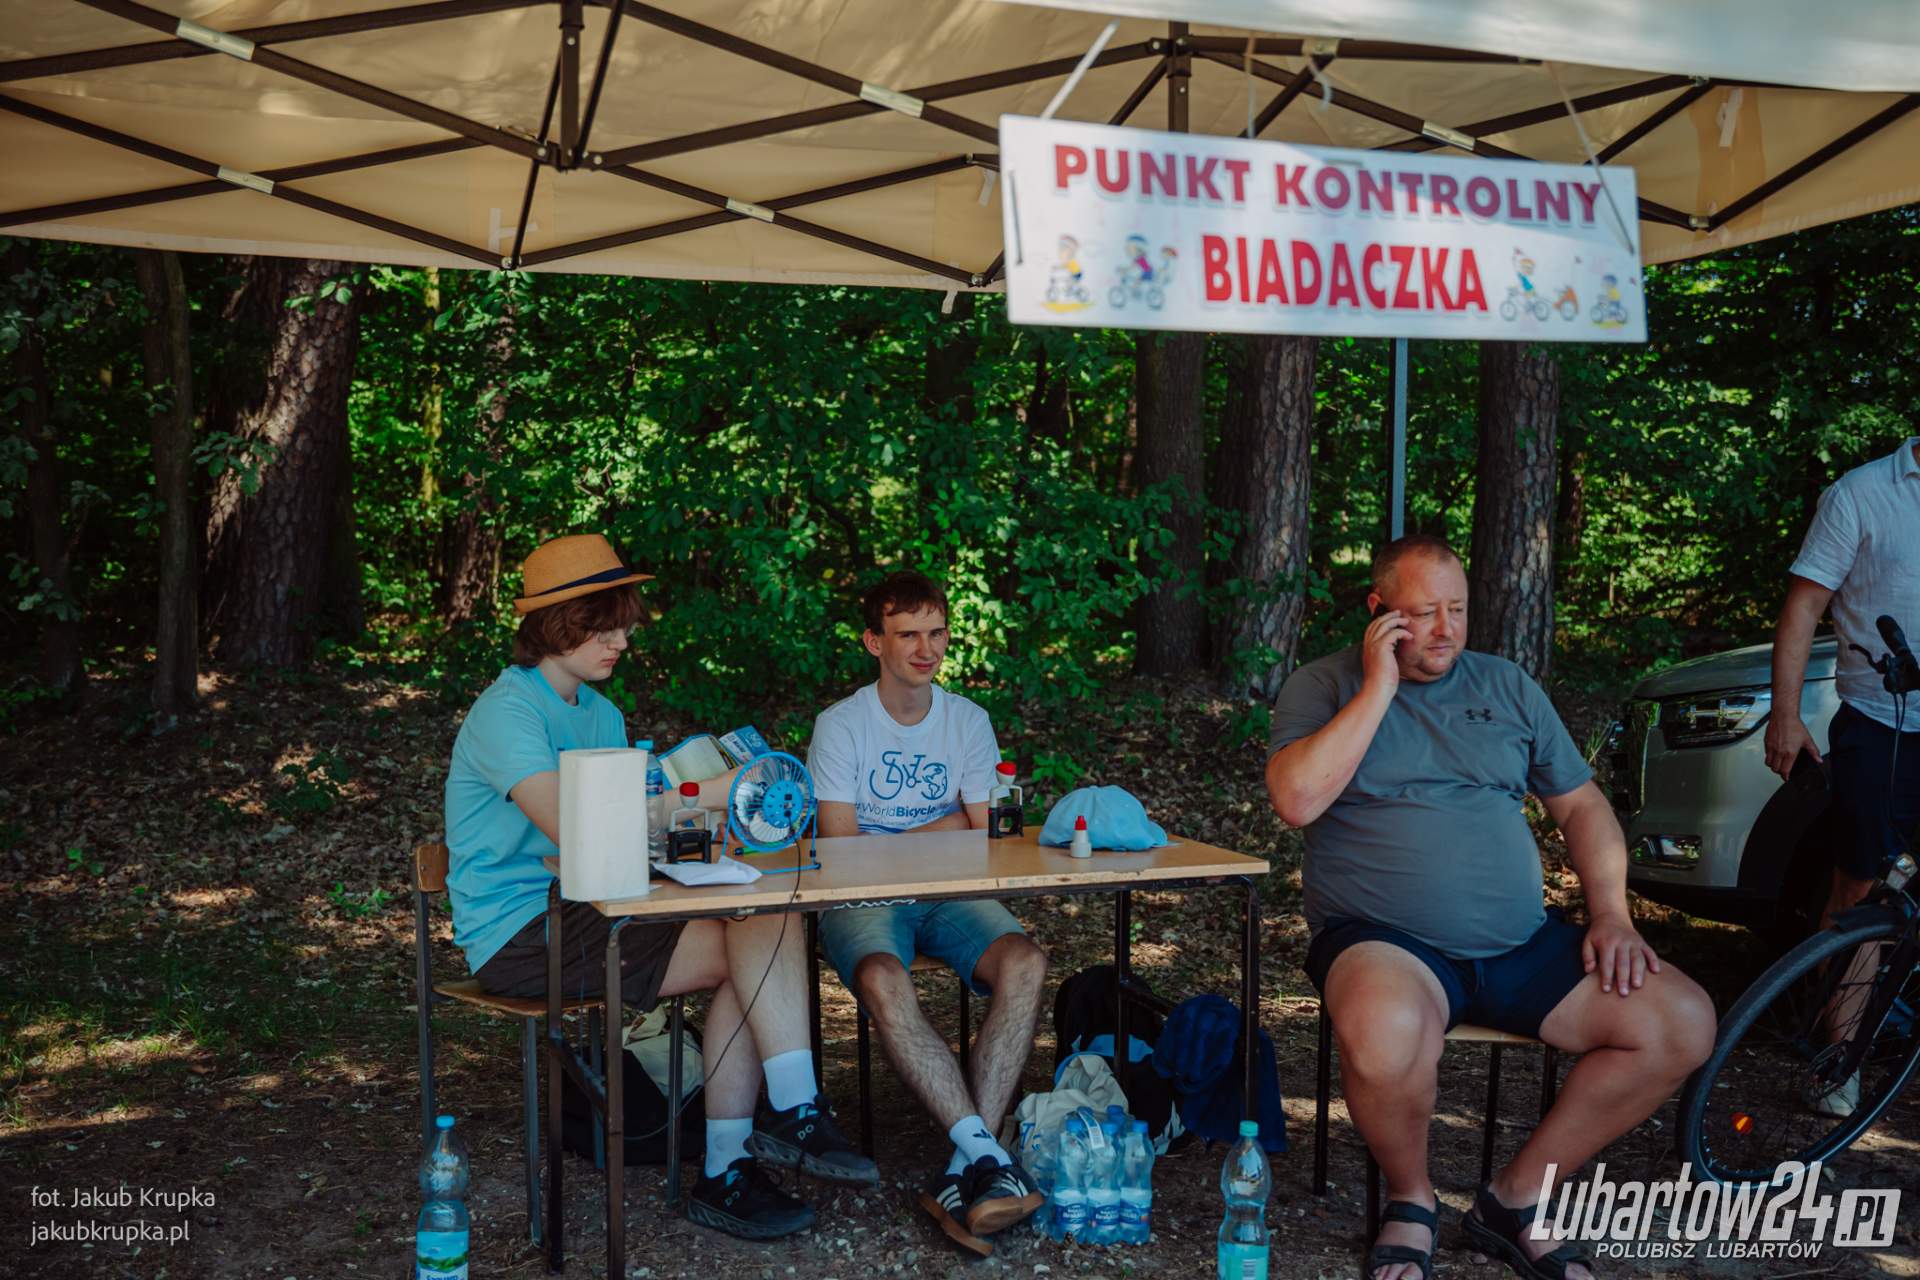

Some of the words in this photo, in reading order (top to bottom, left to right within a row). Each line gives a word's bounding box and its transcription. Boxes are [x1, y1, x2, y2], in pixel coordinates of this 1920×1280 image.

[1053, 143, 1252, 204] PUNKT
[1275, 162, 1604, 224] KONTROLNY
[1201, 234, 1490, 312] BIADACZKA
